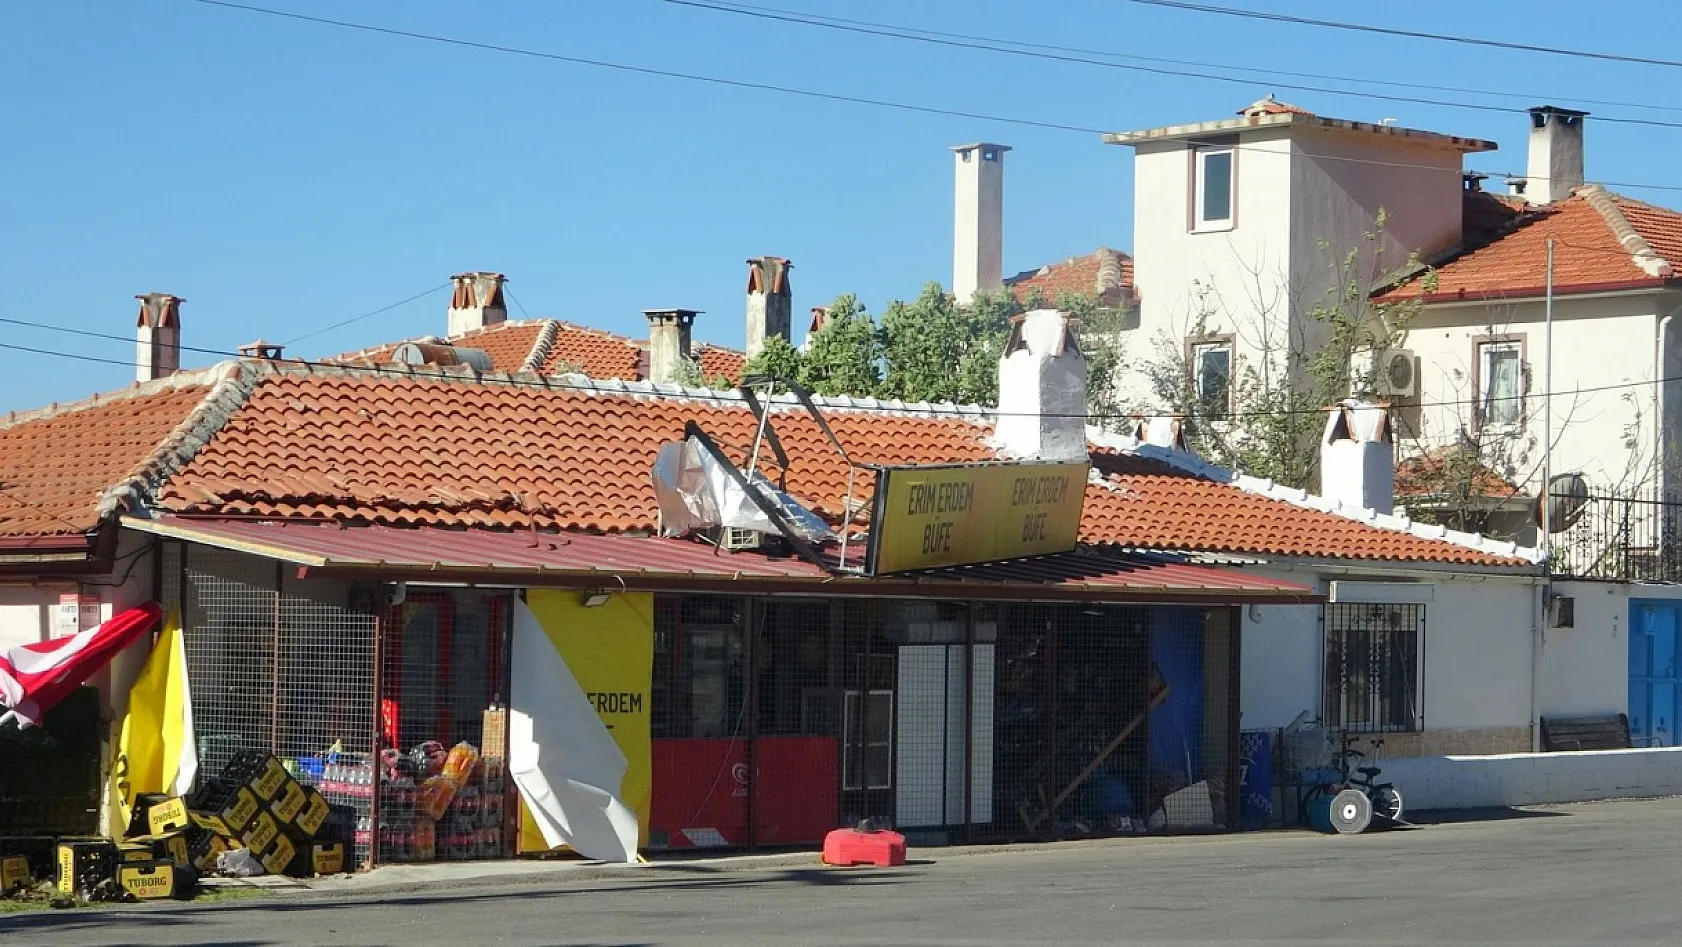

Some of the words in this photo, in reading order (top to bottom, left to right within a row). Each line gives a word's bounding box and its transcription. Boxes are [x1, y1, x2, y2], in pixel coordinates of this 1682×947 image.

[938, 480, 974, 512] ERDEM
[1035, 476, 1069, 504] ERDEM
[923, 516, 953, 554] BÜFE
[128, 876, 166, 888] TUBORG
